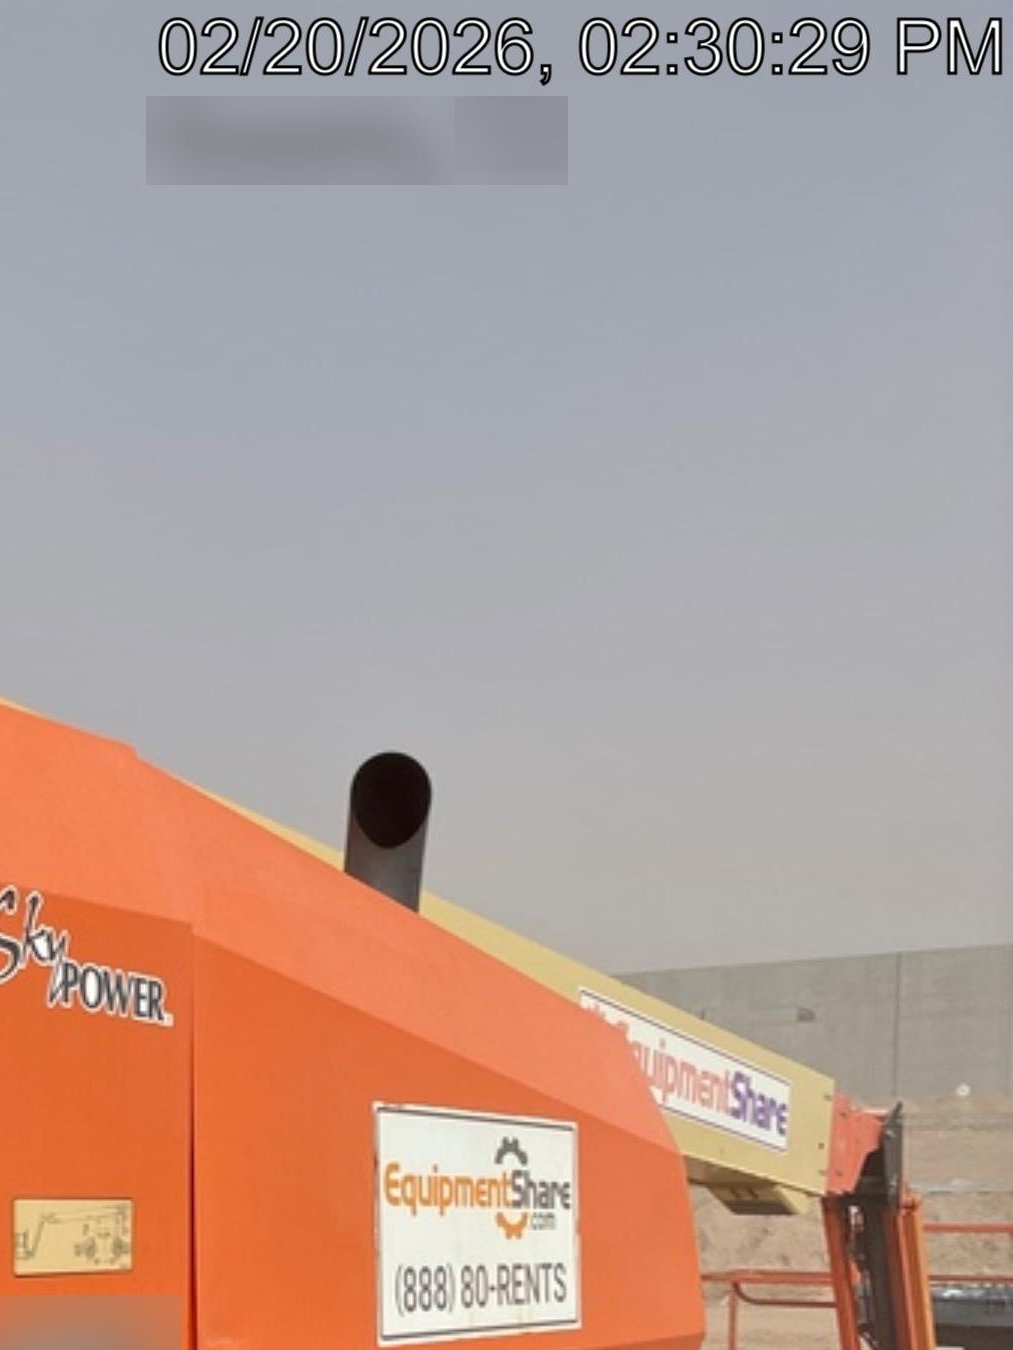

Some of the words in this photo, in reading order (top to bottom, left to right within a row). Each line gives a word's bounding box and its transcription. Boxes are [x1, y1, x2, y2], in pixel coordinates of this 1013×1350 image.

[62, 961, 165, 1022] POWER
[384, 1162, 572, 1217] EquipmentShare
[394, 1264, 456, 1317] (888)
[460, 1262, 568, 1310] 80-RENTS
